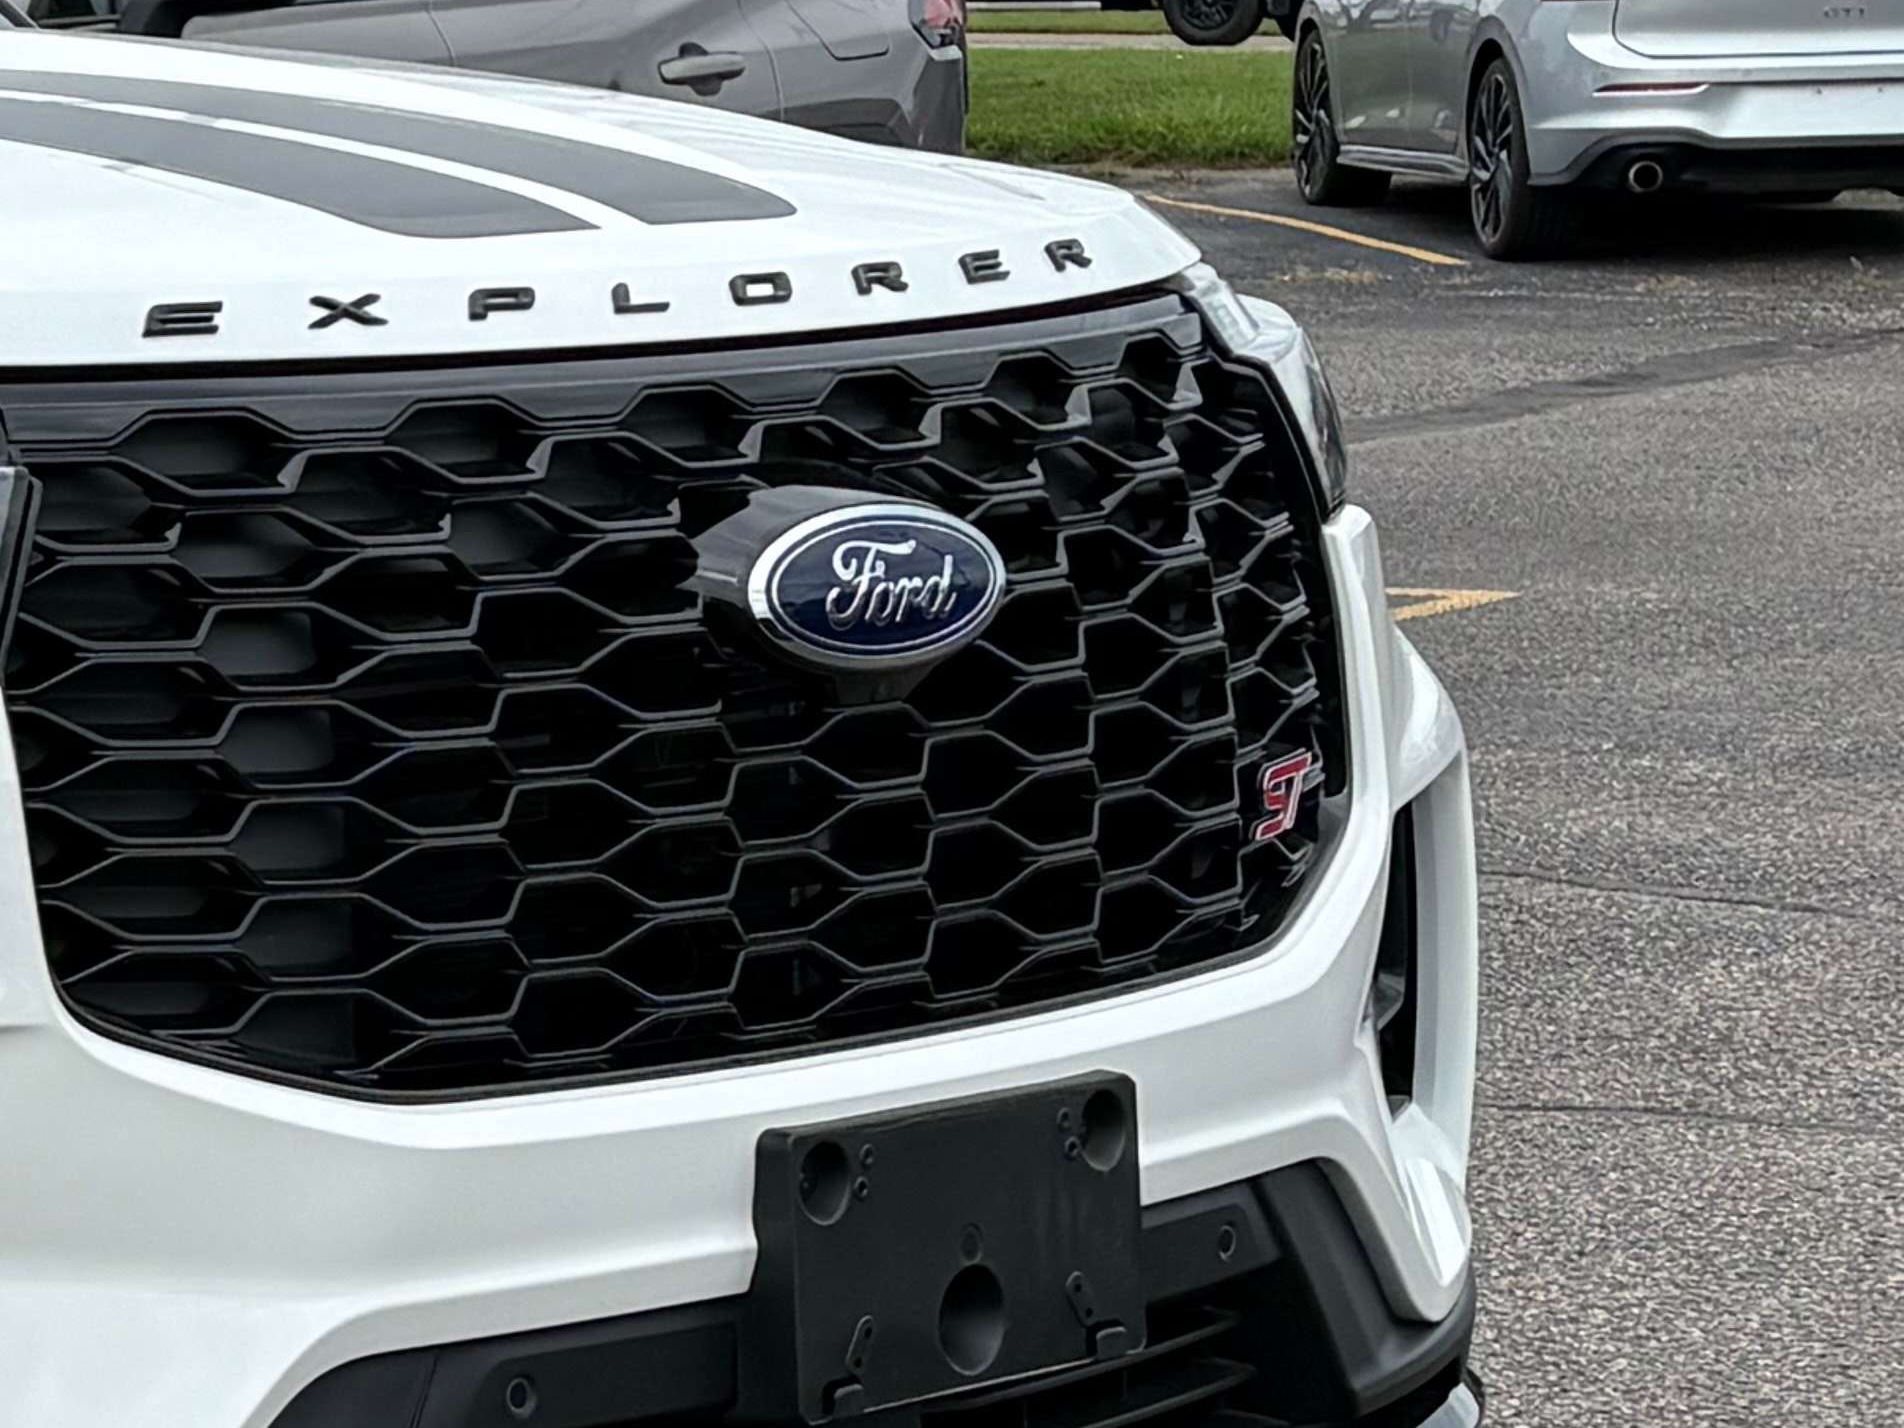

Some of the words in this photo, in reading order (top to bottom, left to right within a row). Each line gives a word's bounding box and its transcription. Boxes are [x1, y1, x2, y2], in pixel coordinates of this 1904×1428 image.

[141, 237, 1095, 339] EXPLORER
[824, 538, 958, 631] Ford
[1252, 748, 1313, 841] ST
